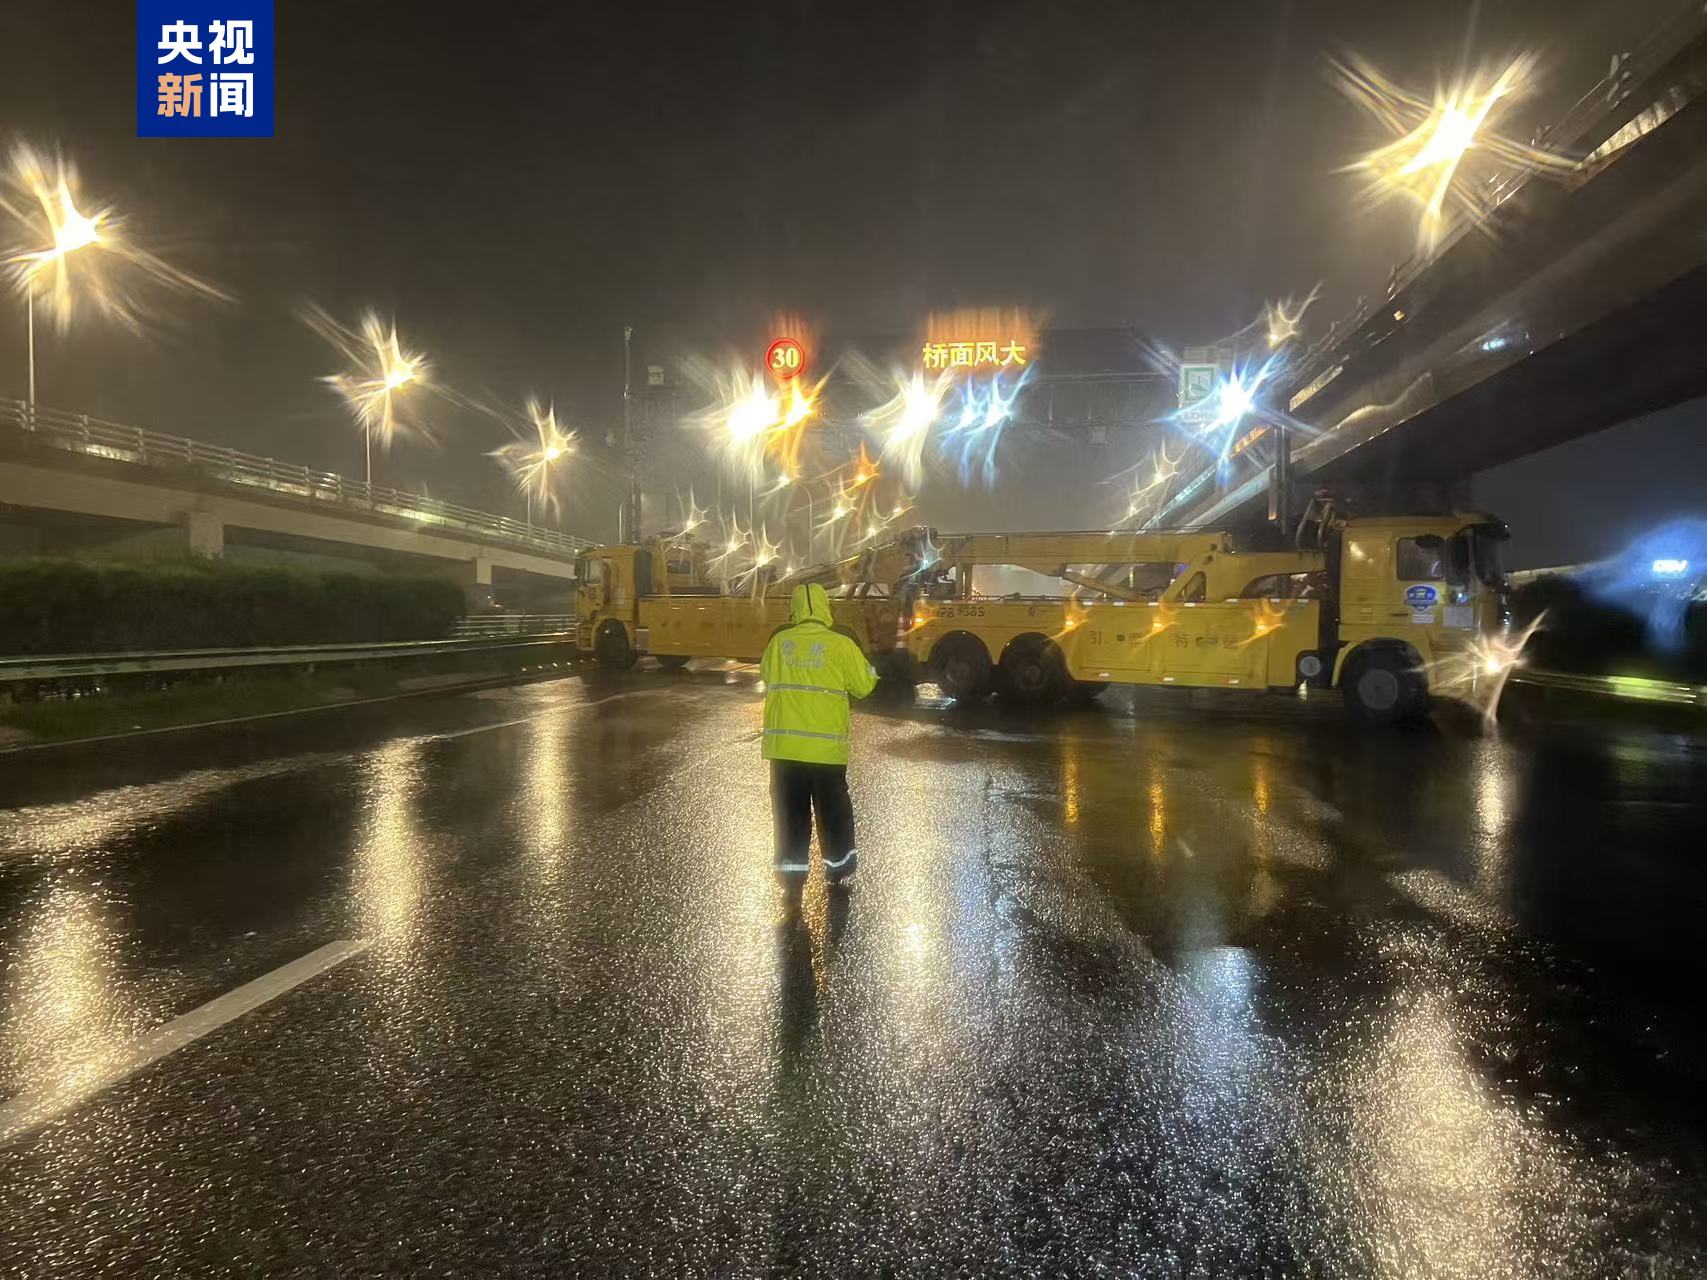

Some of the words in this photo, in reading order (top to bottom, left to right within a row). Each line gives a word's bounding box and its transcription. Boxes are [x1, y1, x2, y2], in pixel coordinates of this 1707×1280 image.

[771, 347, 799, 369] 30
[922, 340, 1026, 369] 桥面风大
